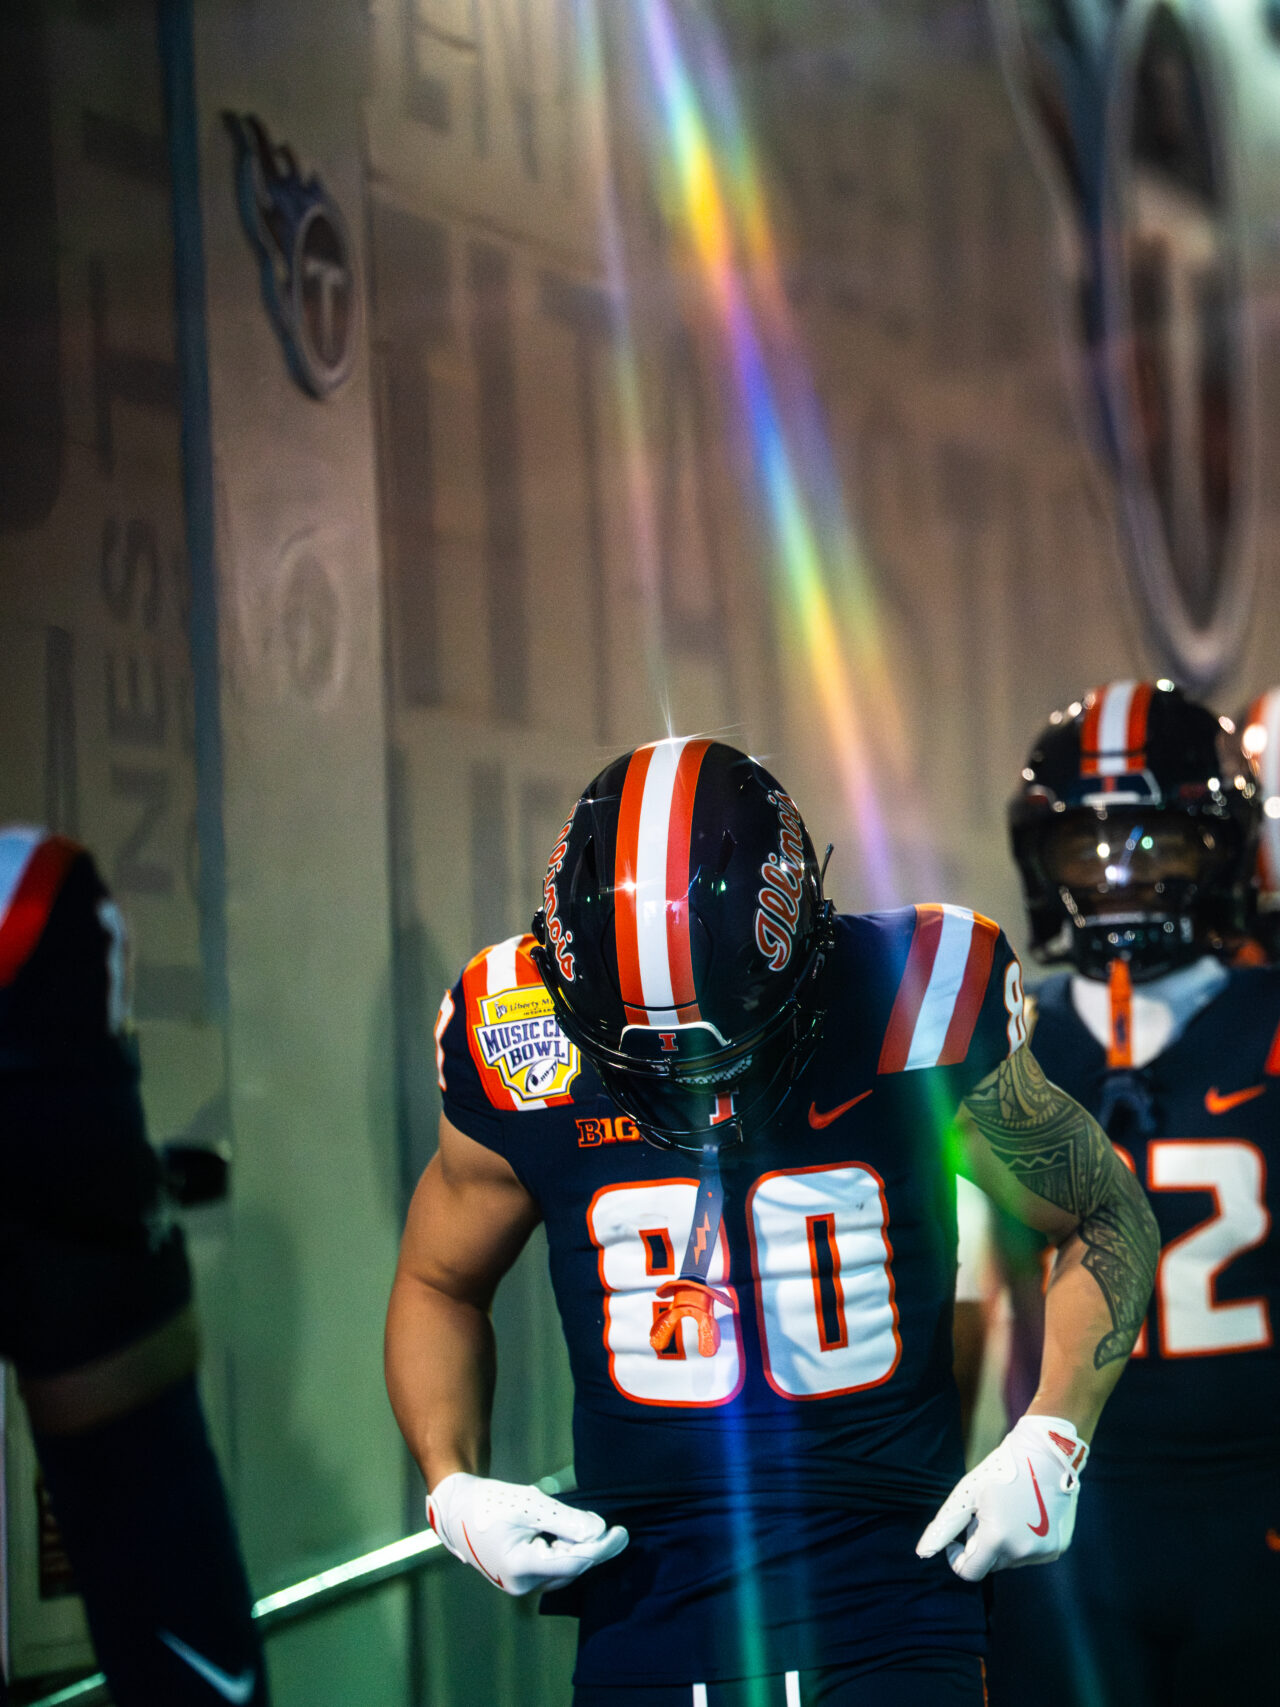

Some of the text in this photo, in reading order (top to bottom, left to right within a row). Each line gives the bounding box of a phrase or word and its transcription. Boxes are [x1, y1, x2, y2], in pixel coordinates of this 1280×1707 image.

[482, 1019, 566, 1057] MUSIC CI
[508, 1040, 566, 1068] BOWL
[658, 1032, 679, 1051] I
[586, 1161, 902, 1409] 80
